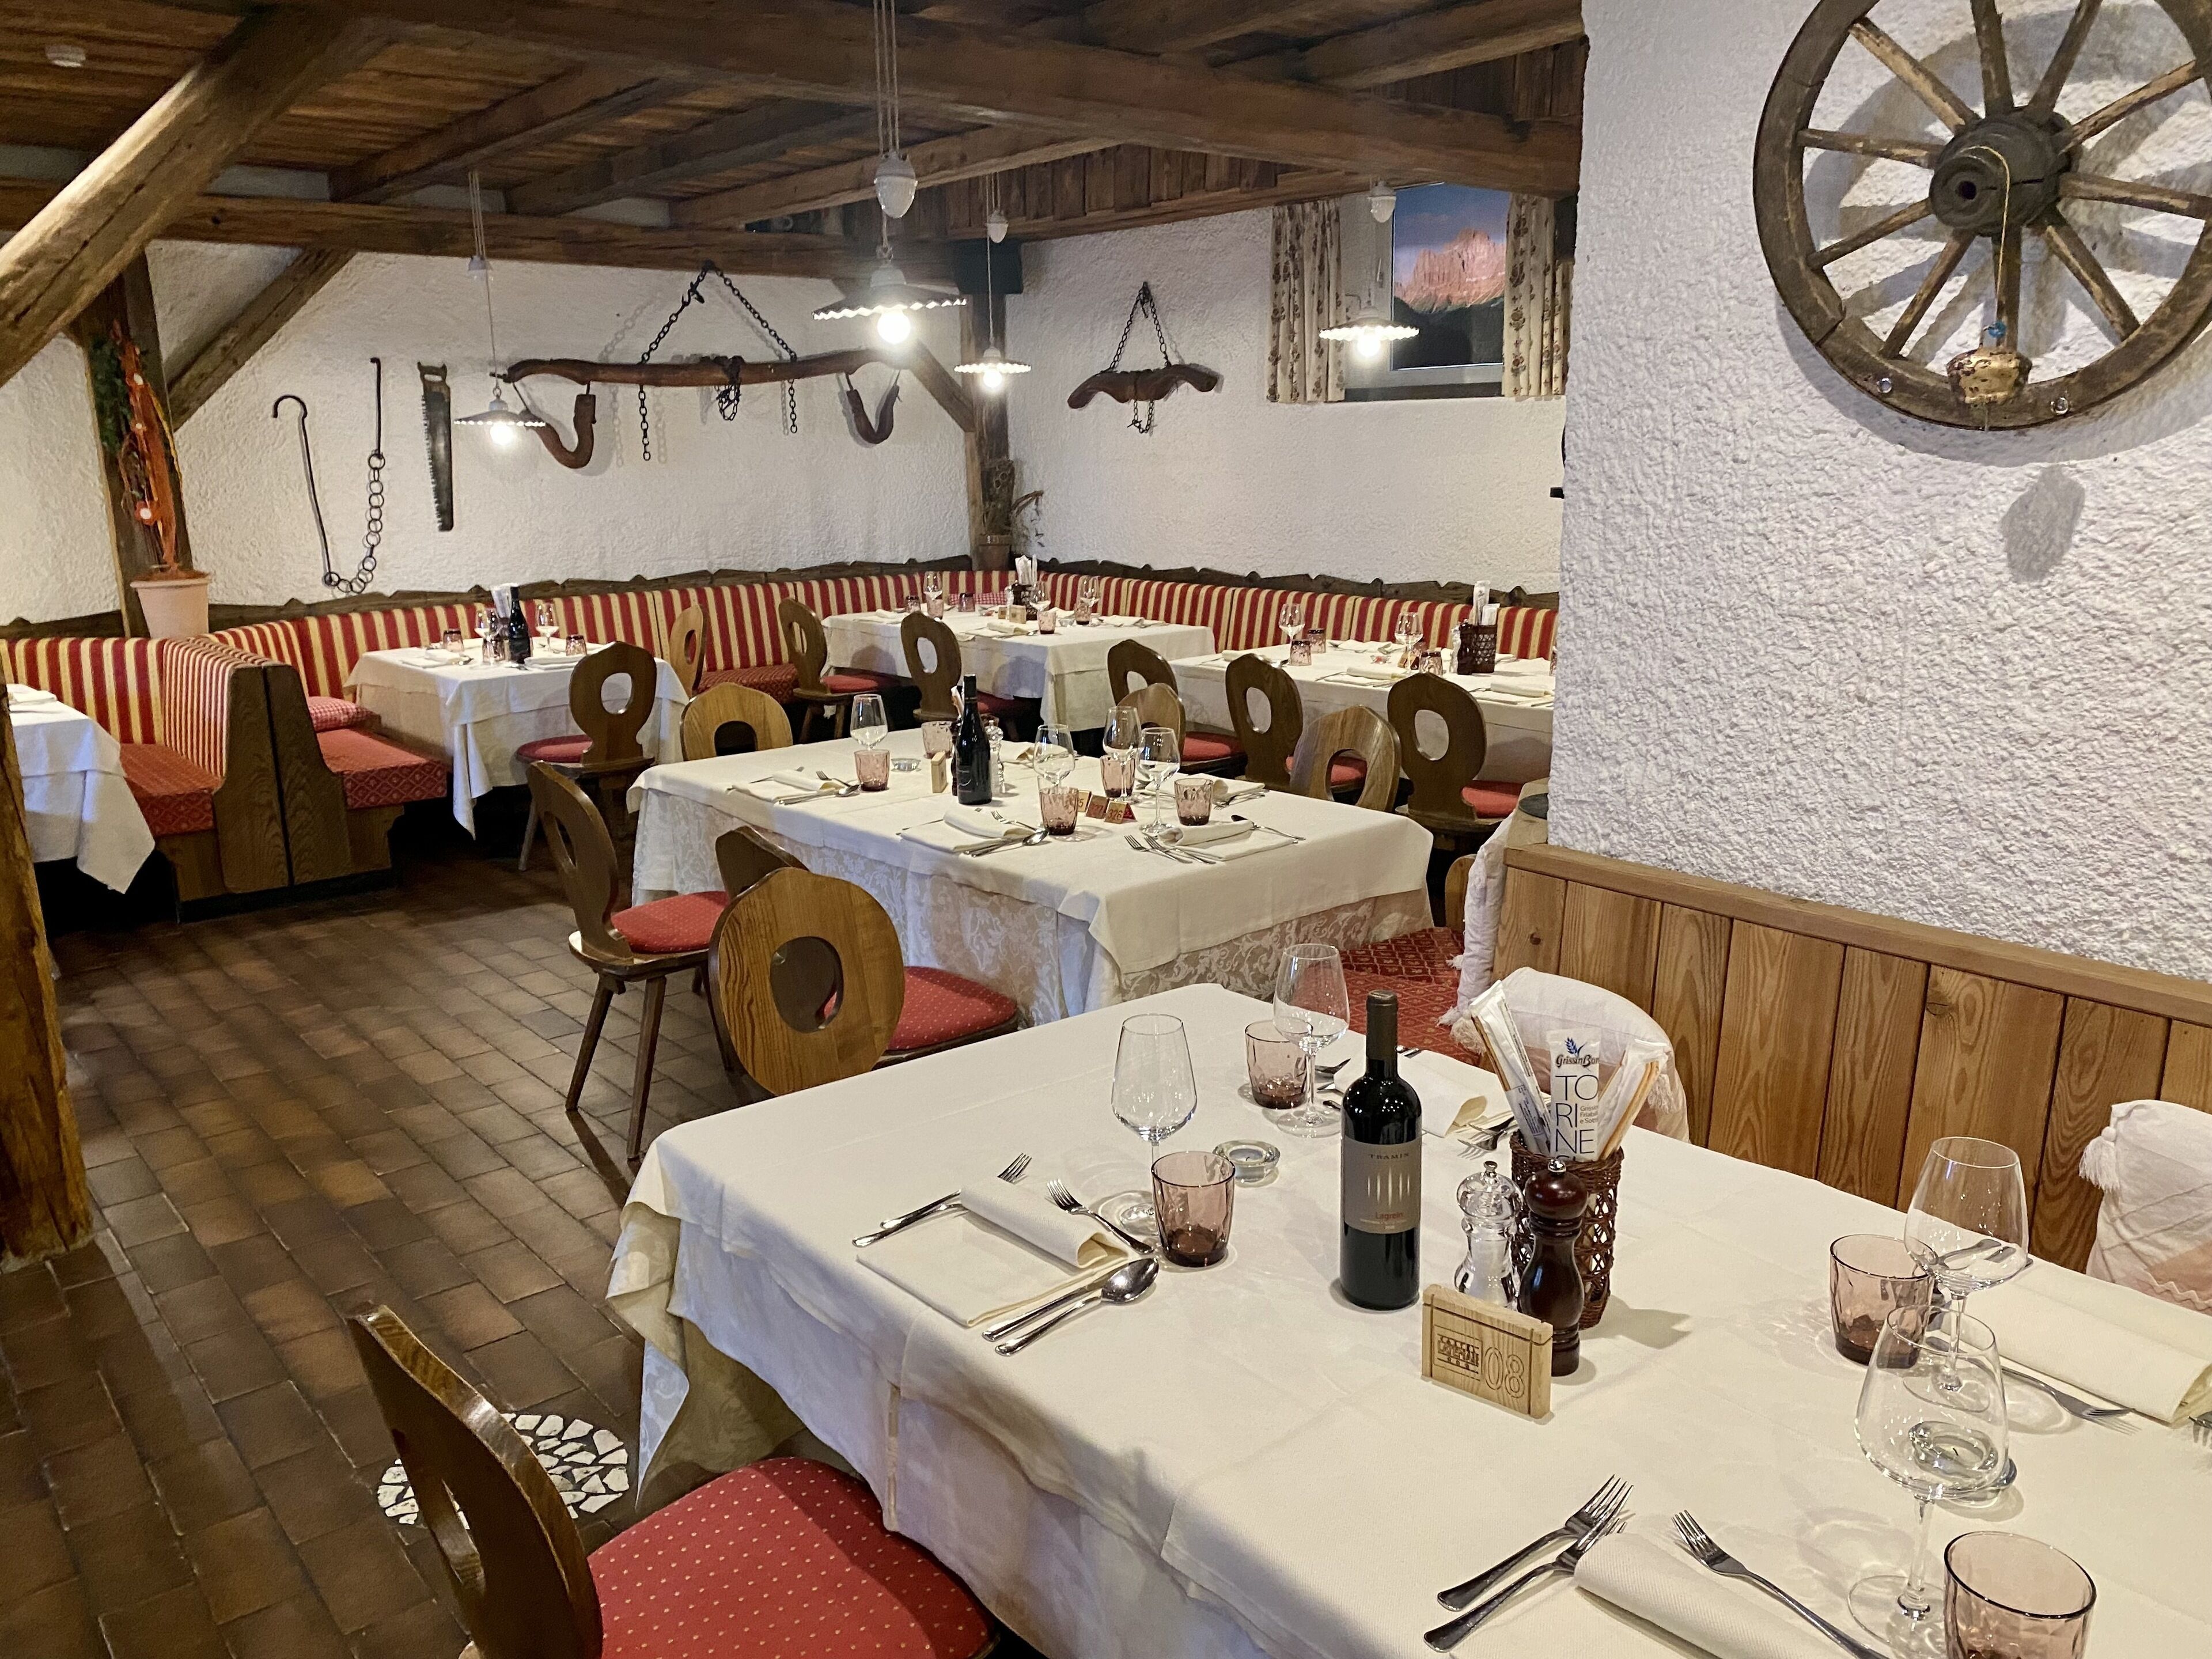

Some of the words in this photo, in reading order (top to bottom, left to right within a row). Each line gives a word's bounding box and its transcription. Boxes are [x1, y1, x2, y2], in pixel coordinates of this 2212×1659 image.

[1555, 1074, 1599, 1100] TO
[1556, 1103, 1577, 1127] RI
[1555, 1128, 1594, 1154] NE
[1375, 1211, 1403, 1220] Lagrein
[1484, 1346, 1525, 1399] 08
